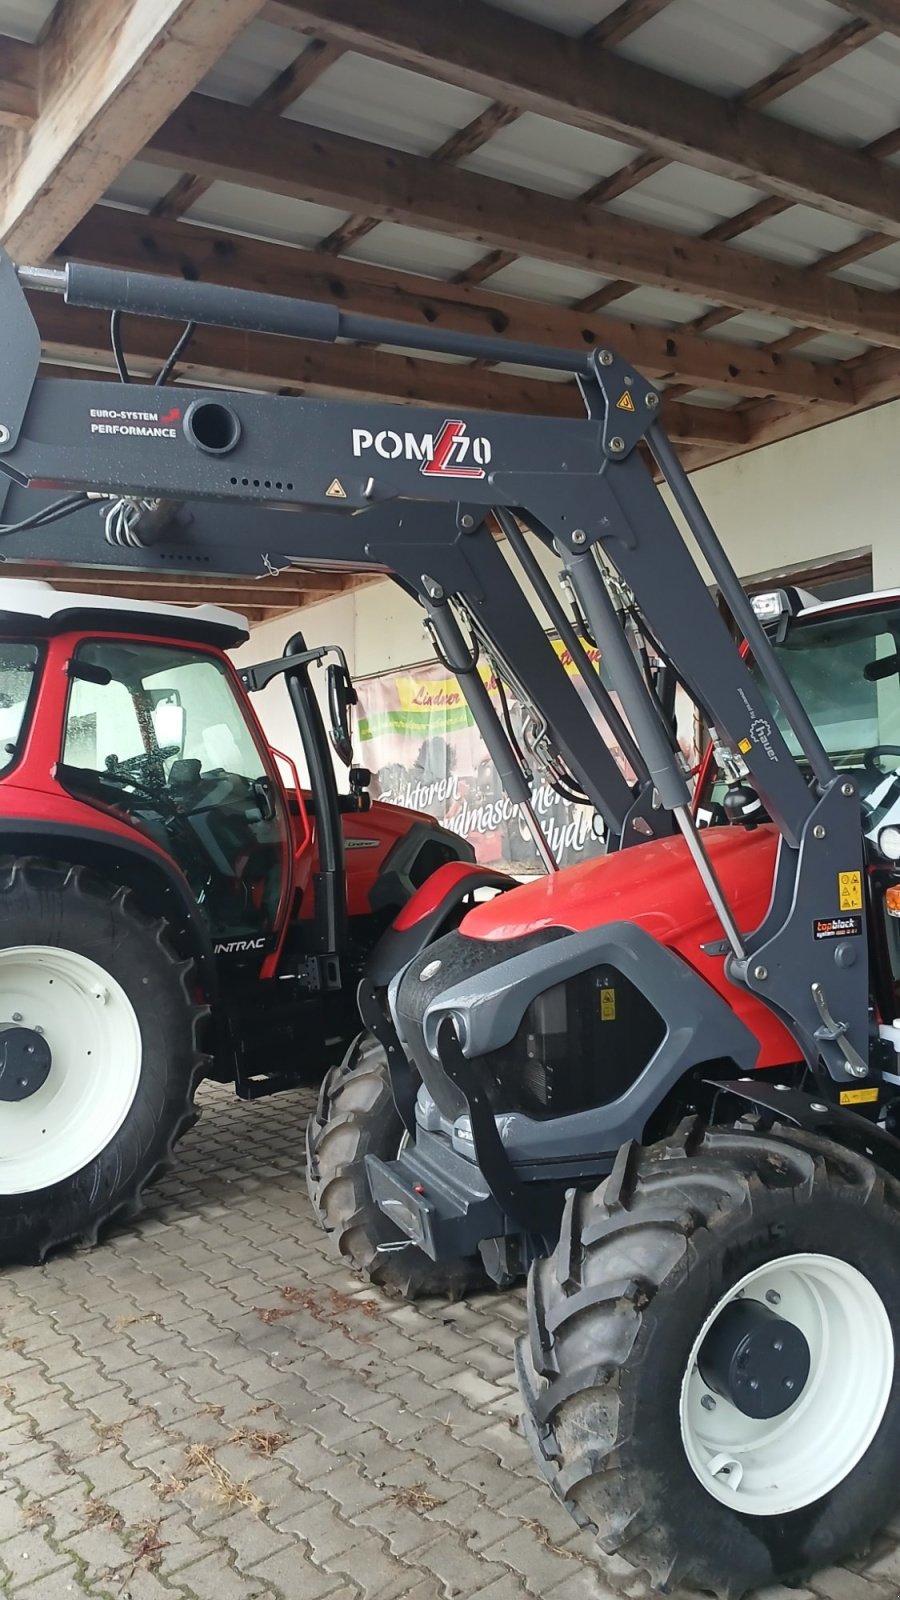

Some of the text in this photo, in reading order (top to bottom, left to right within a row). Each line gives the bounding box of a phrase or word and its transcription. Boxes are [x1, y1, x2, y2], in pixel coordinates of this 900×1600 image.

[90, 409, 158, 421] EURO-SYSTEM
[91, 424, 177, 438] PERFORMANCE
[755, 726, 779, 762] hauer
[817, 918, 855, 932] topblock
[214, 937, 266, 954] INTRAC
